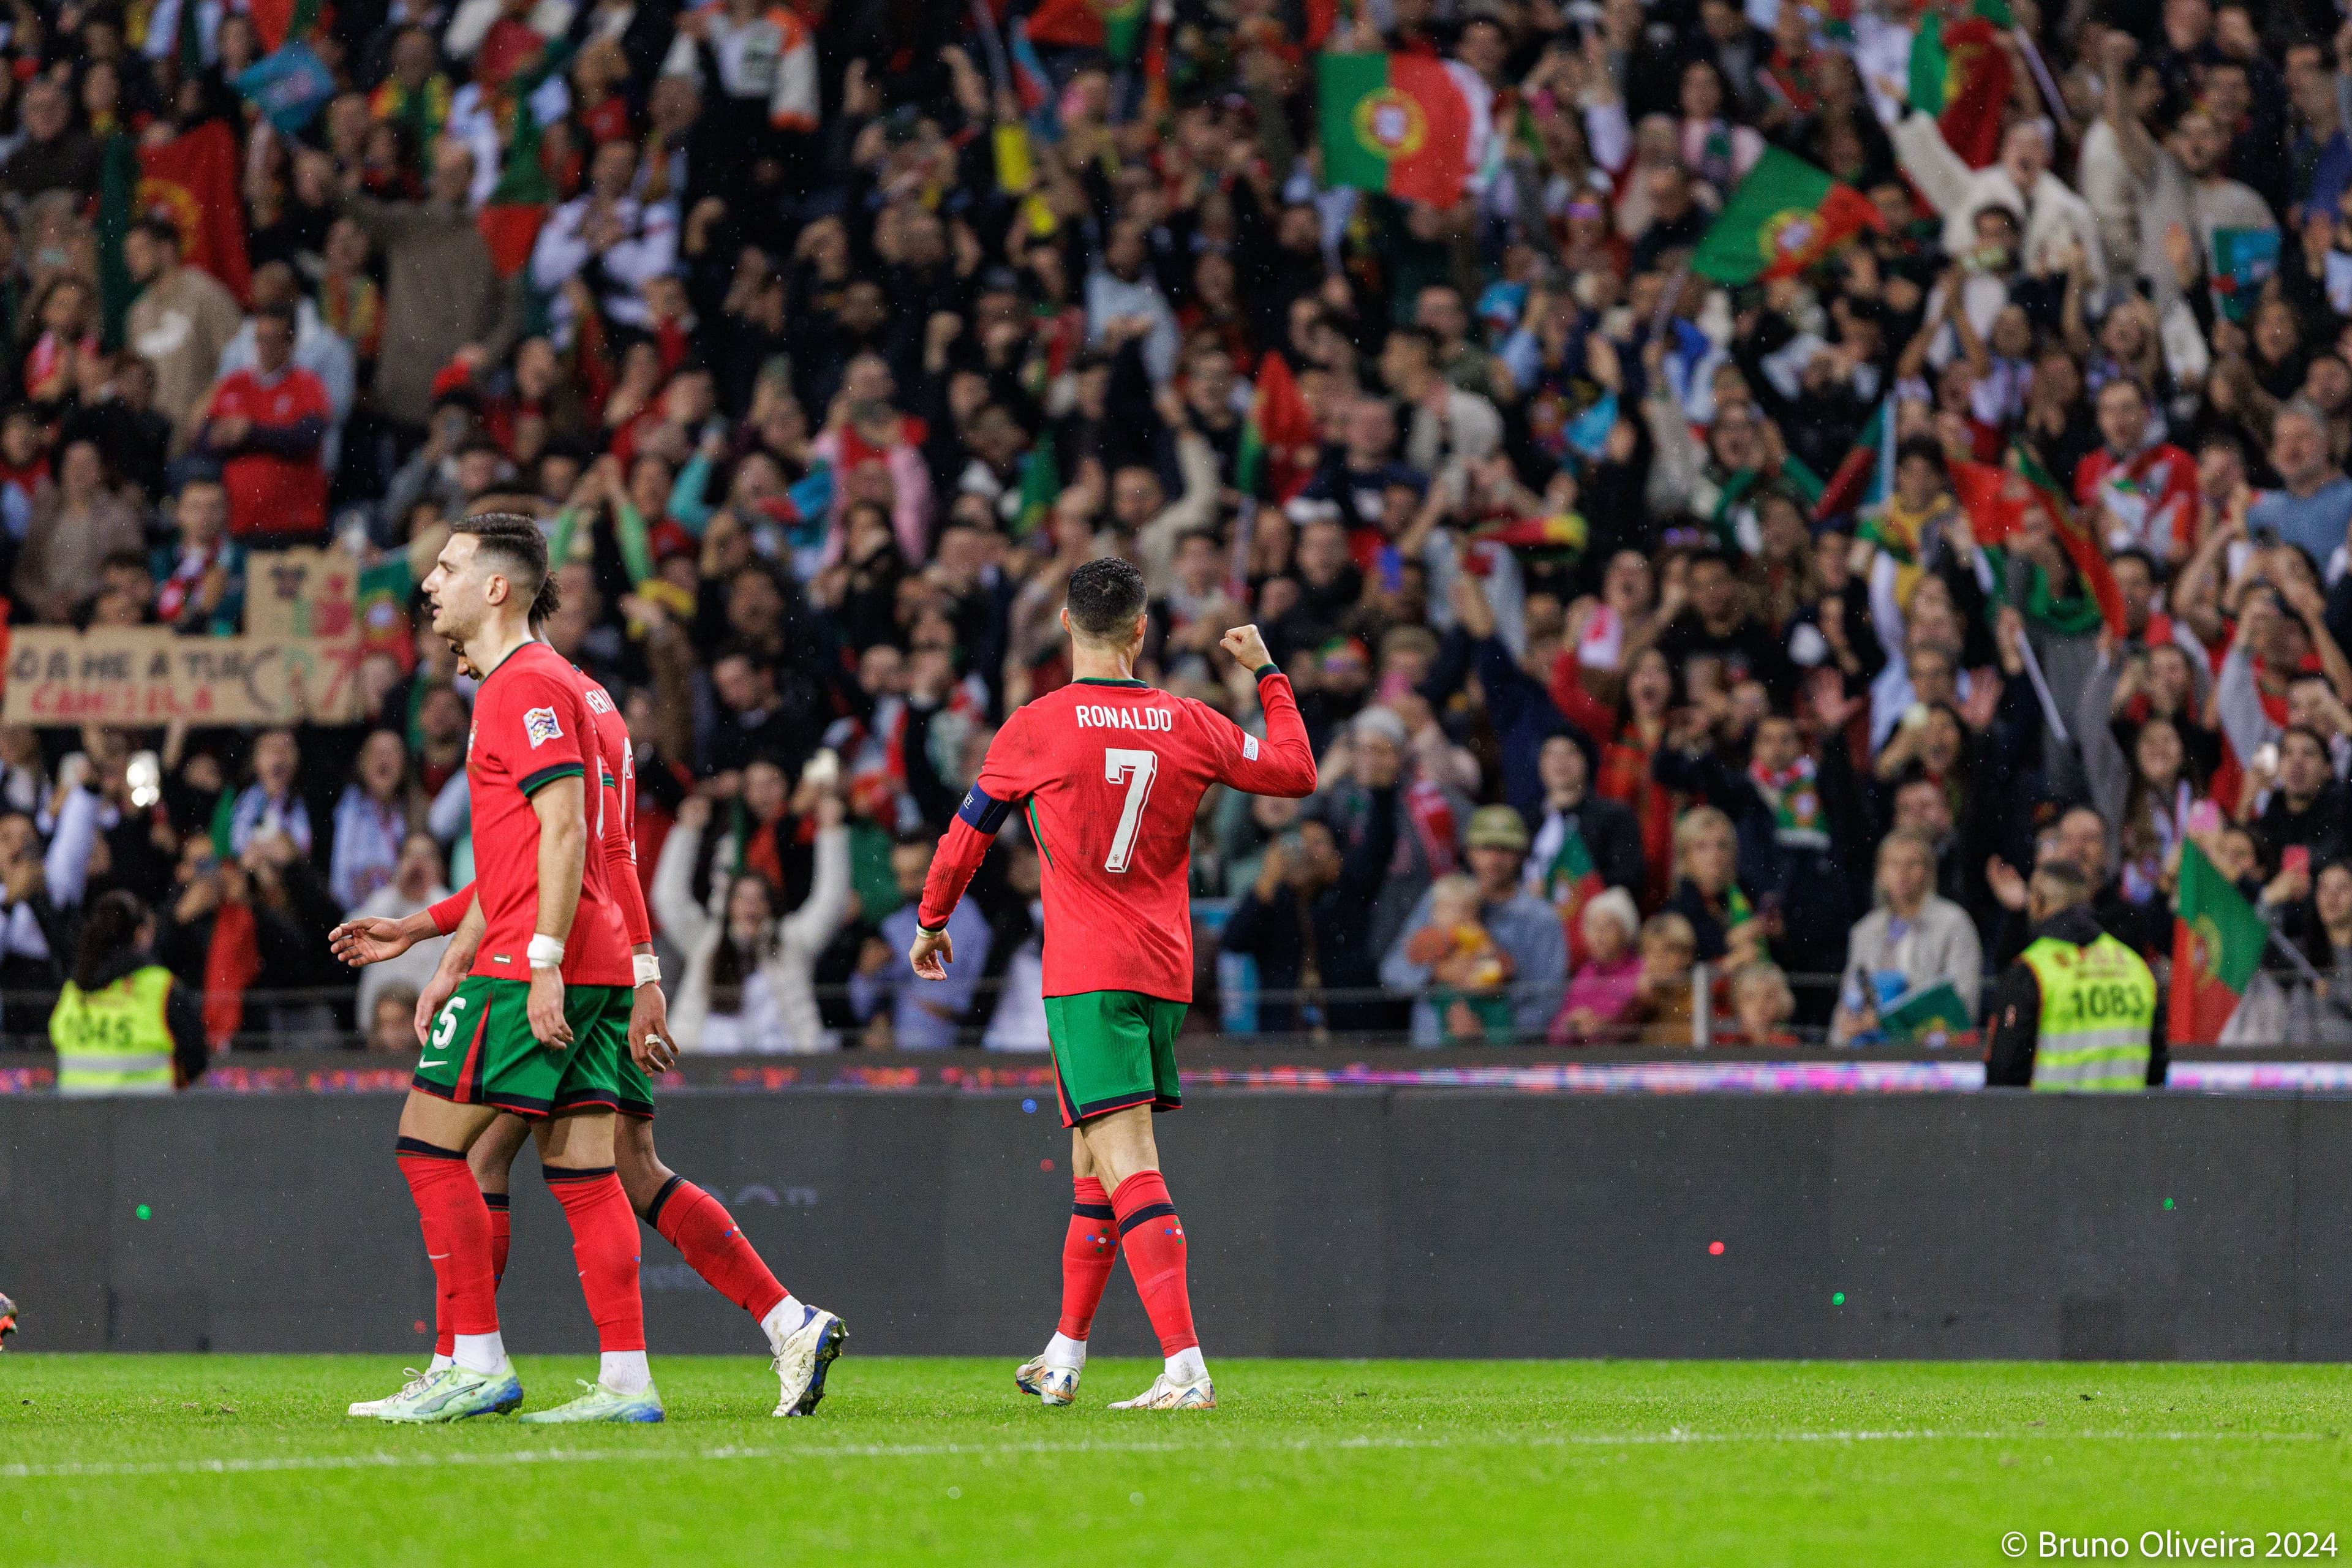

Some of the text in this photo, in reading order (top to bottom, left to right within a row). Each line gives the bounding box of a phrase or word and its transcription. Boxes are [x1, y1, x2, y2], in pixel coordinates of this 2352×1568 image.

[1076, 705, 1172, 731] RONALDO
[1105, 748, 1158, 873] 7
[432, 997, 466, 1049] 5
